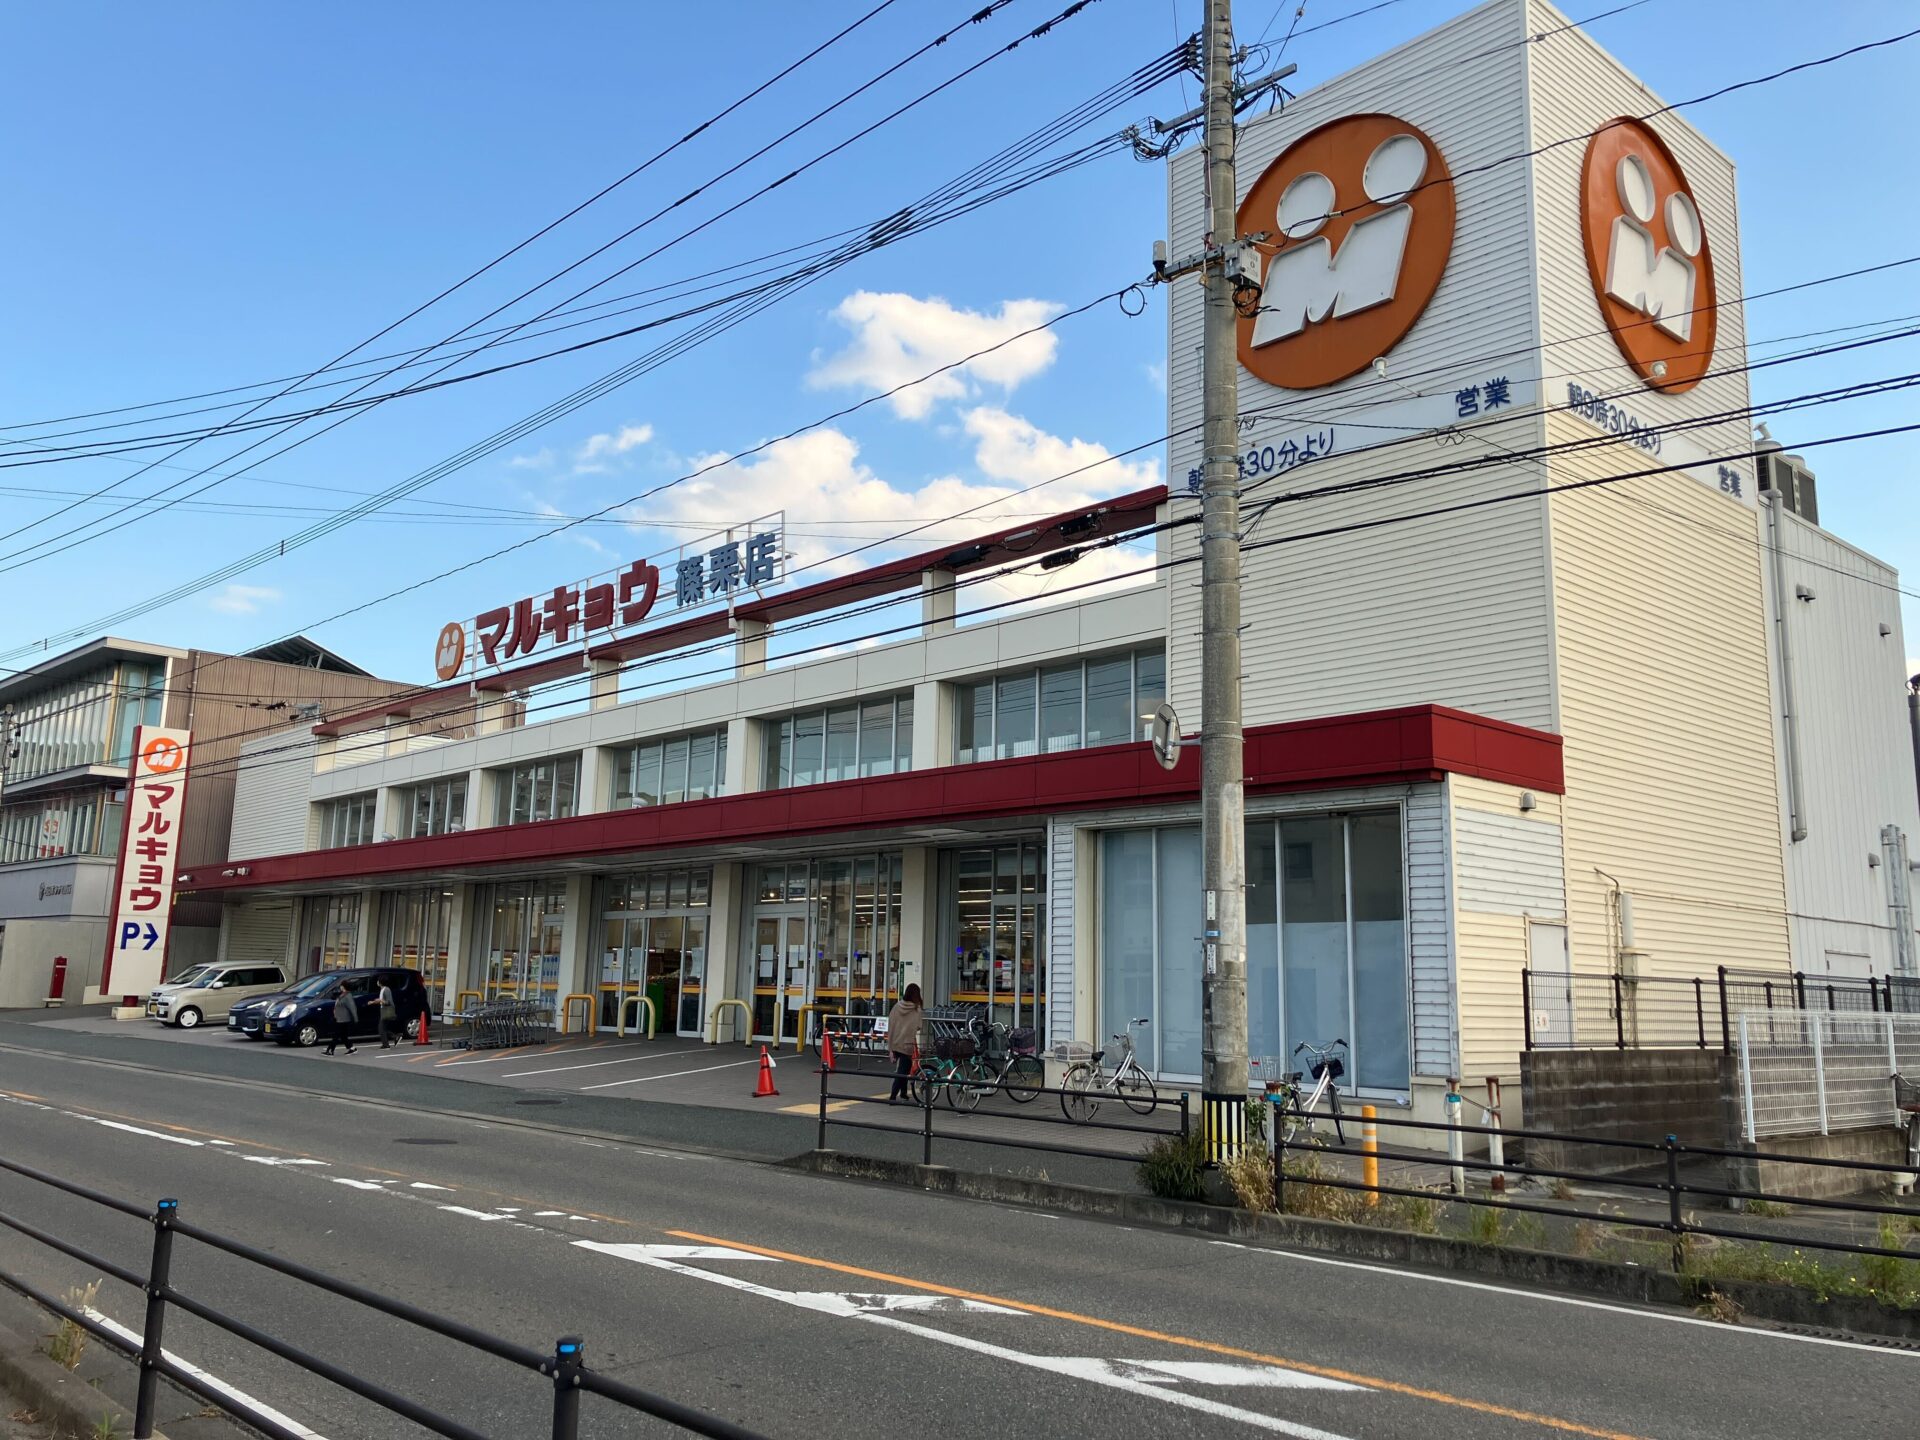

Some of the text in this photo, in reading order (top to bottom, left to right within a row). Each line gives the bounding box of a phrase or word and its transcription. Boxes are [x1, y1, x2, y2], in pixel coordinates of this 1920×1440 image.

[1188, 376, 1511, 494] 30分より 営業
[1718, 464, 1743, 498] 営業
[476, 533, 776, 664] マルキョウ 篠栗店
[129, 783, 175, 911] マルキョウ
[120, 922, 140, 949] P
